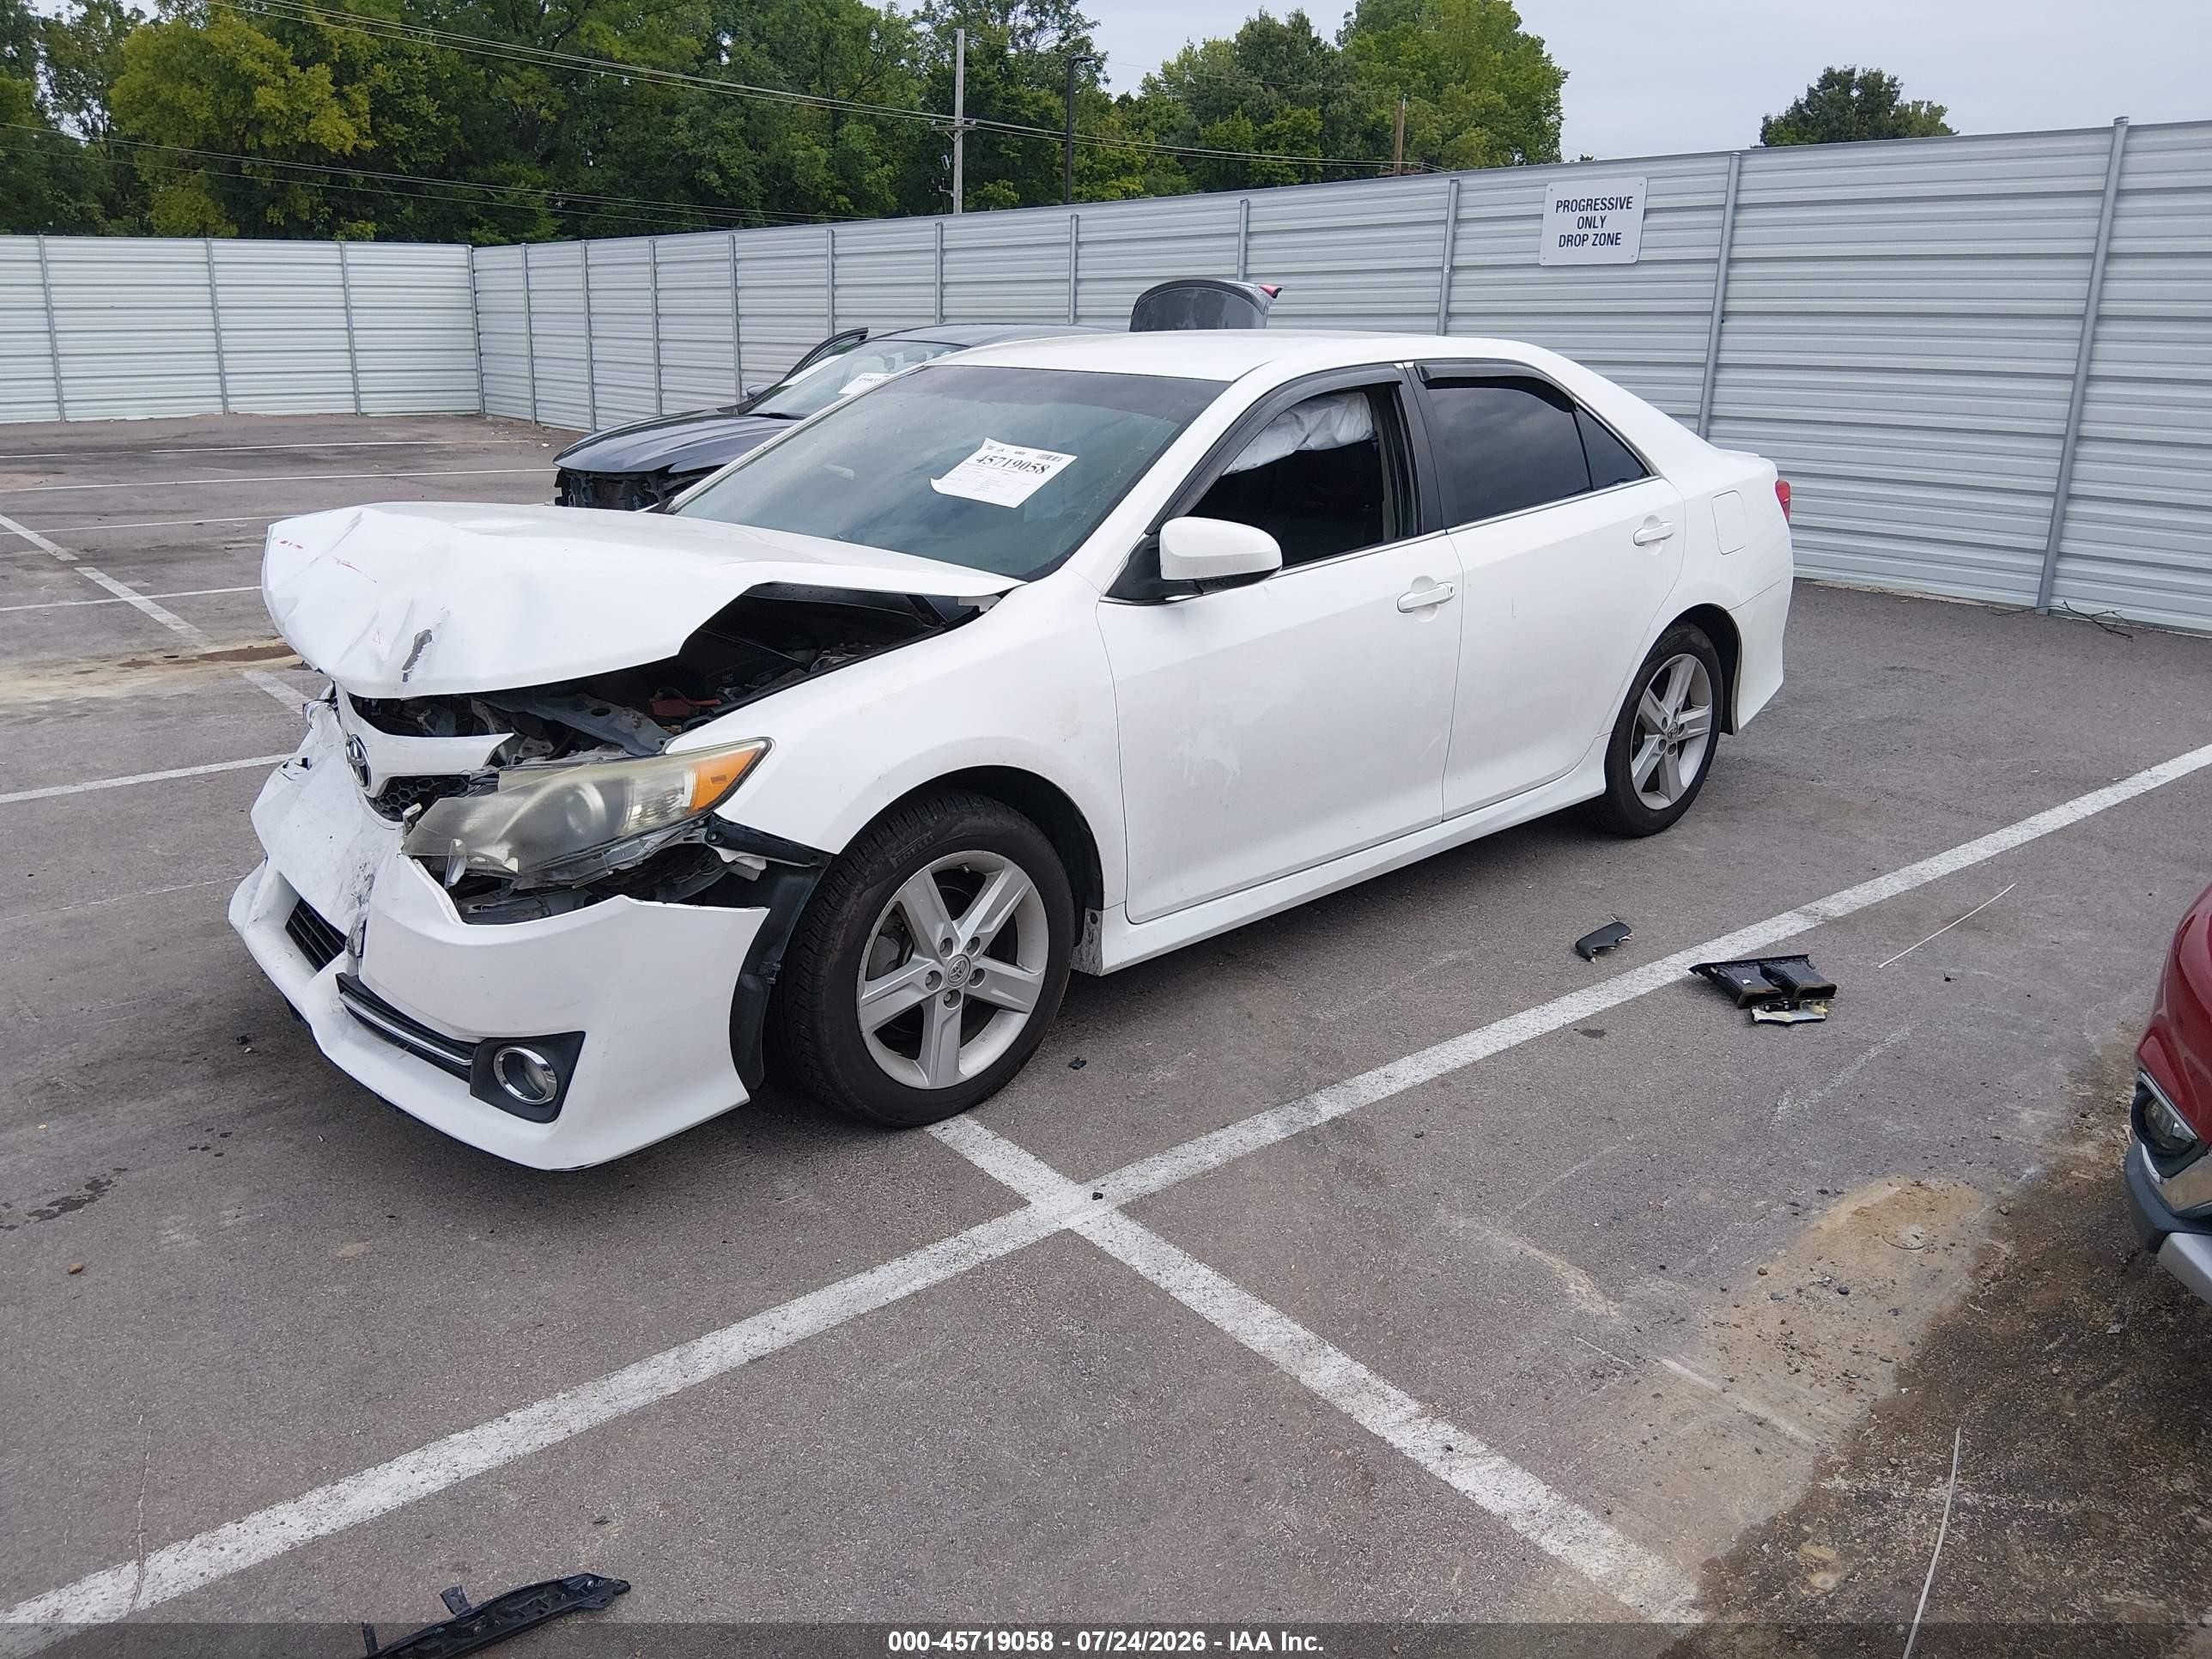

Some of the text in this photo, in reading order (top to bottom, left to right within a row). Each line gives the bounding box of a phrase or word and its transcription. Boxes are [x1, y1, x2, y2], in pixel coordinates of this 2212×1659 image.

[1555, 196, 1633, 214] PROGRESSIVE
[1577, 215, 1607, 229] ONLY
[1558, 232, 1622, 248] DROP ZONE
[975, 454, 1050, 474] 45719058
